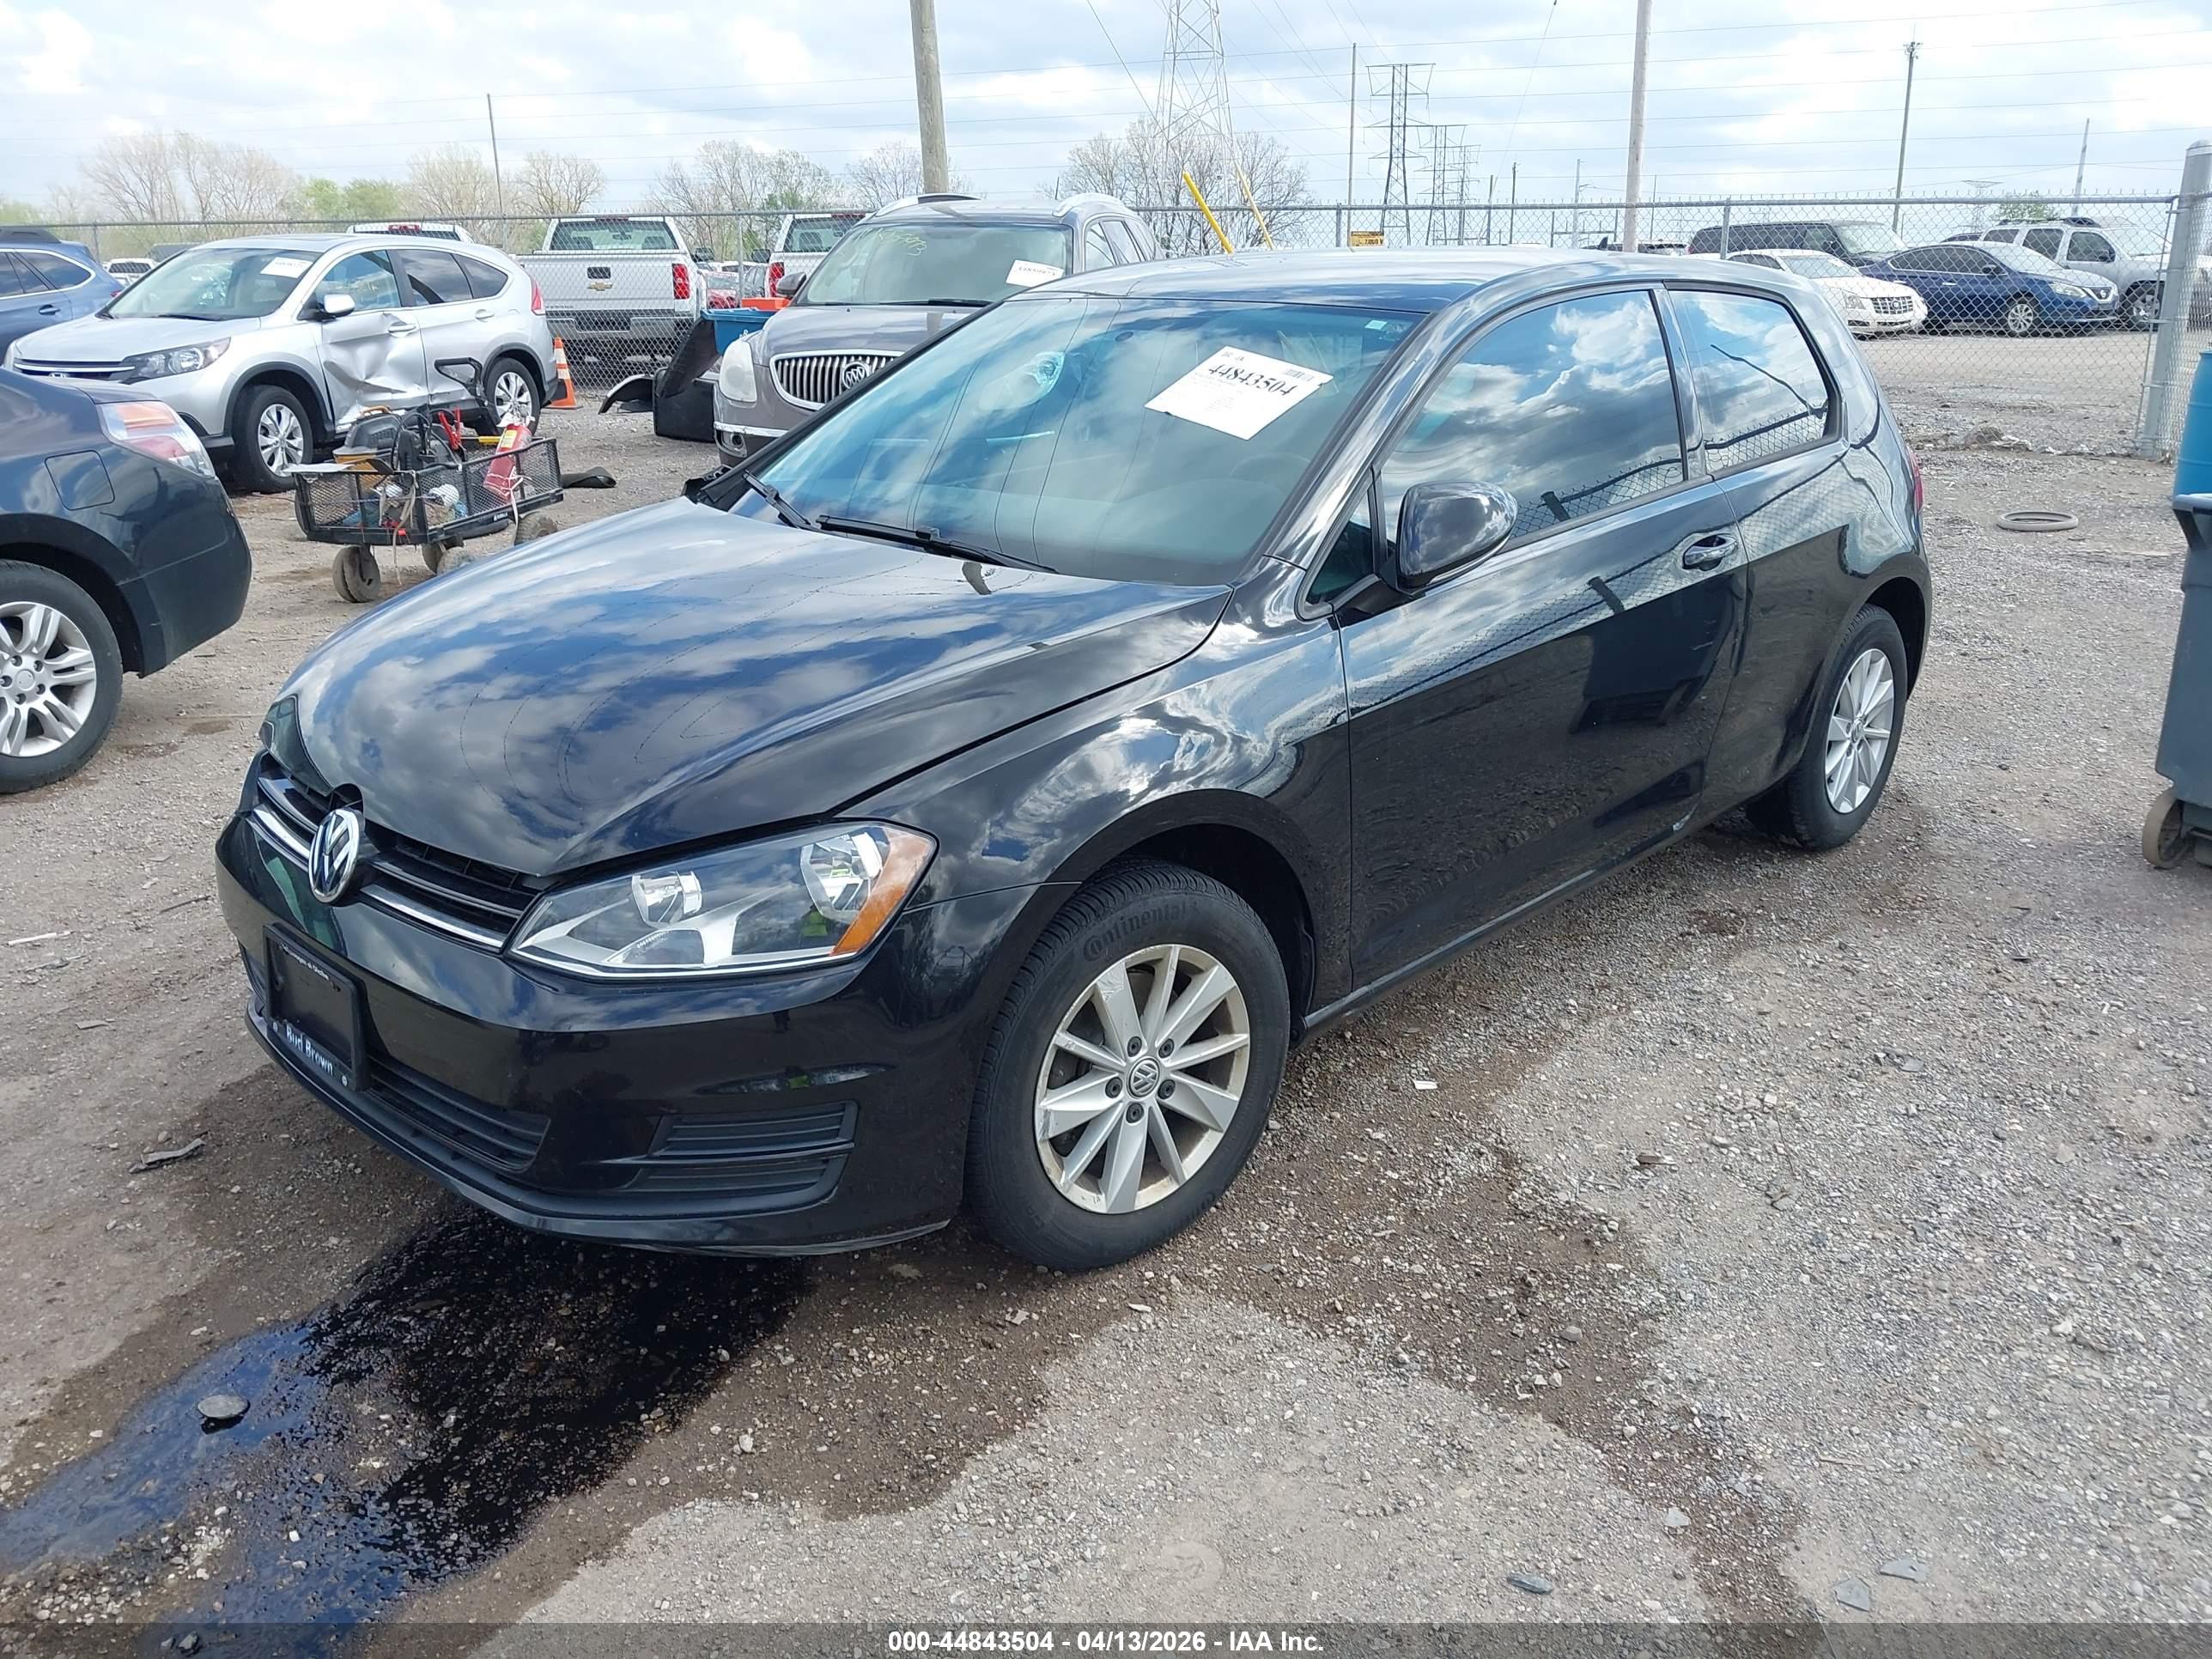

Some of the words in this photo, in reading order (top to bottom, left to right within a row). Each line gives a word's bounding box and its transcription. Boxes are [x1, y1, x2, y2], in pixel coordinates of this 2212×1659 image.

[1208, 364, 1299, 396] 44843504
[1083, 900, 1187, 963] Continental
[286, 1024, 303, 1053] Bud
[305, 1038, 333, 1077] Brown
